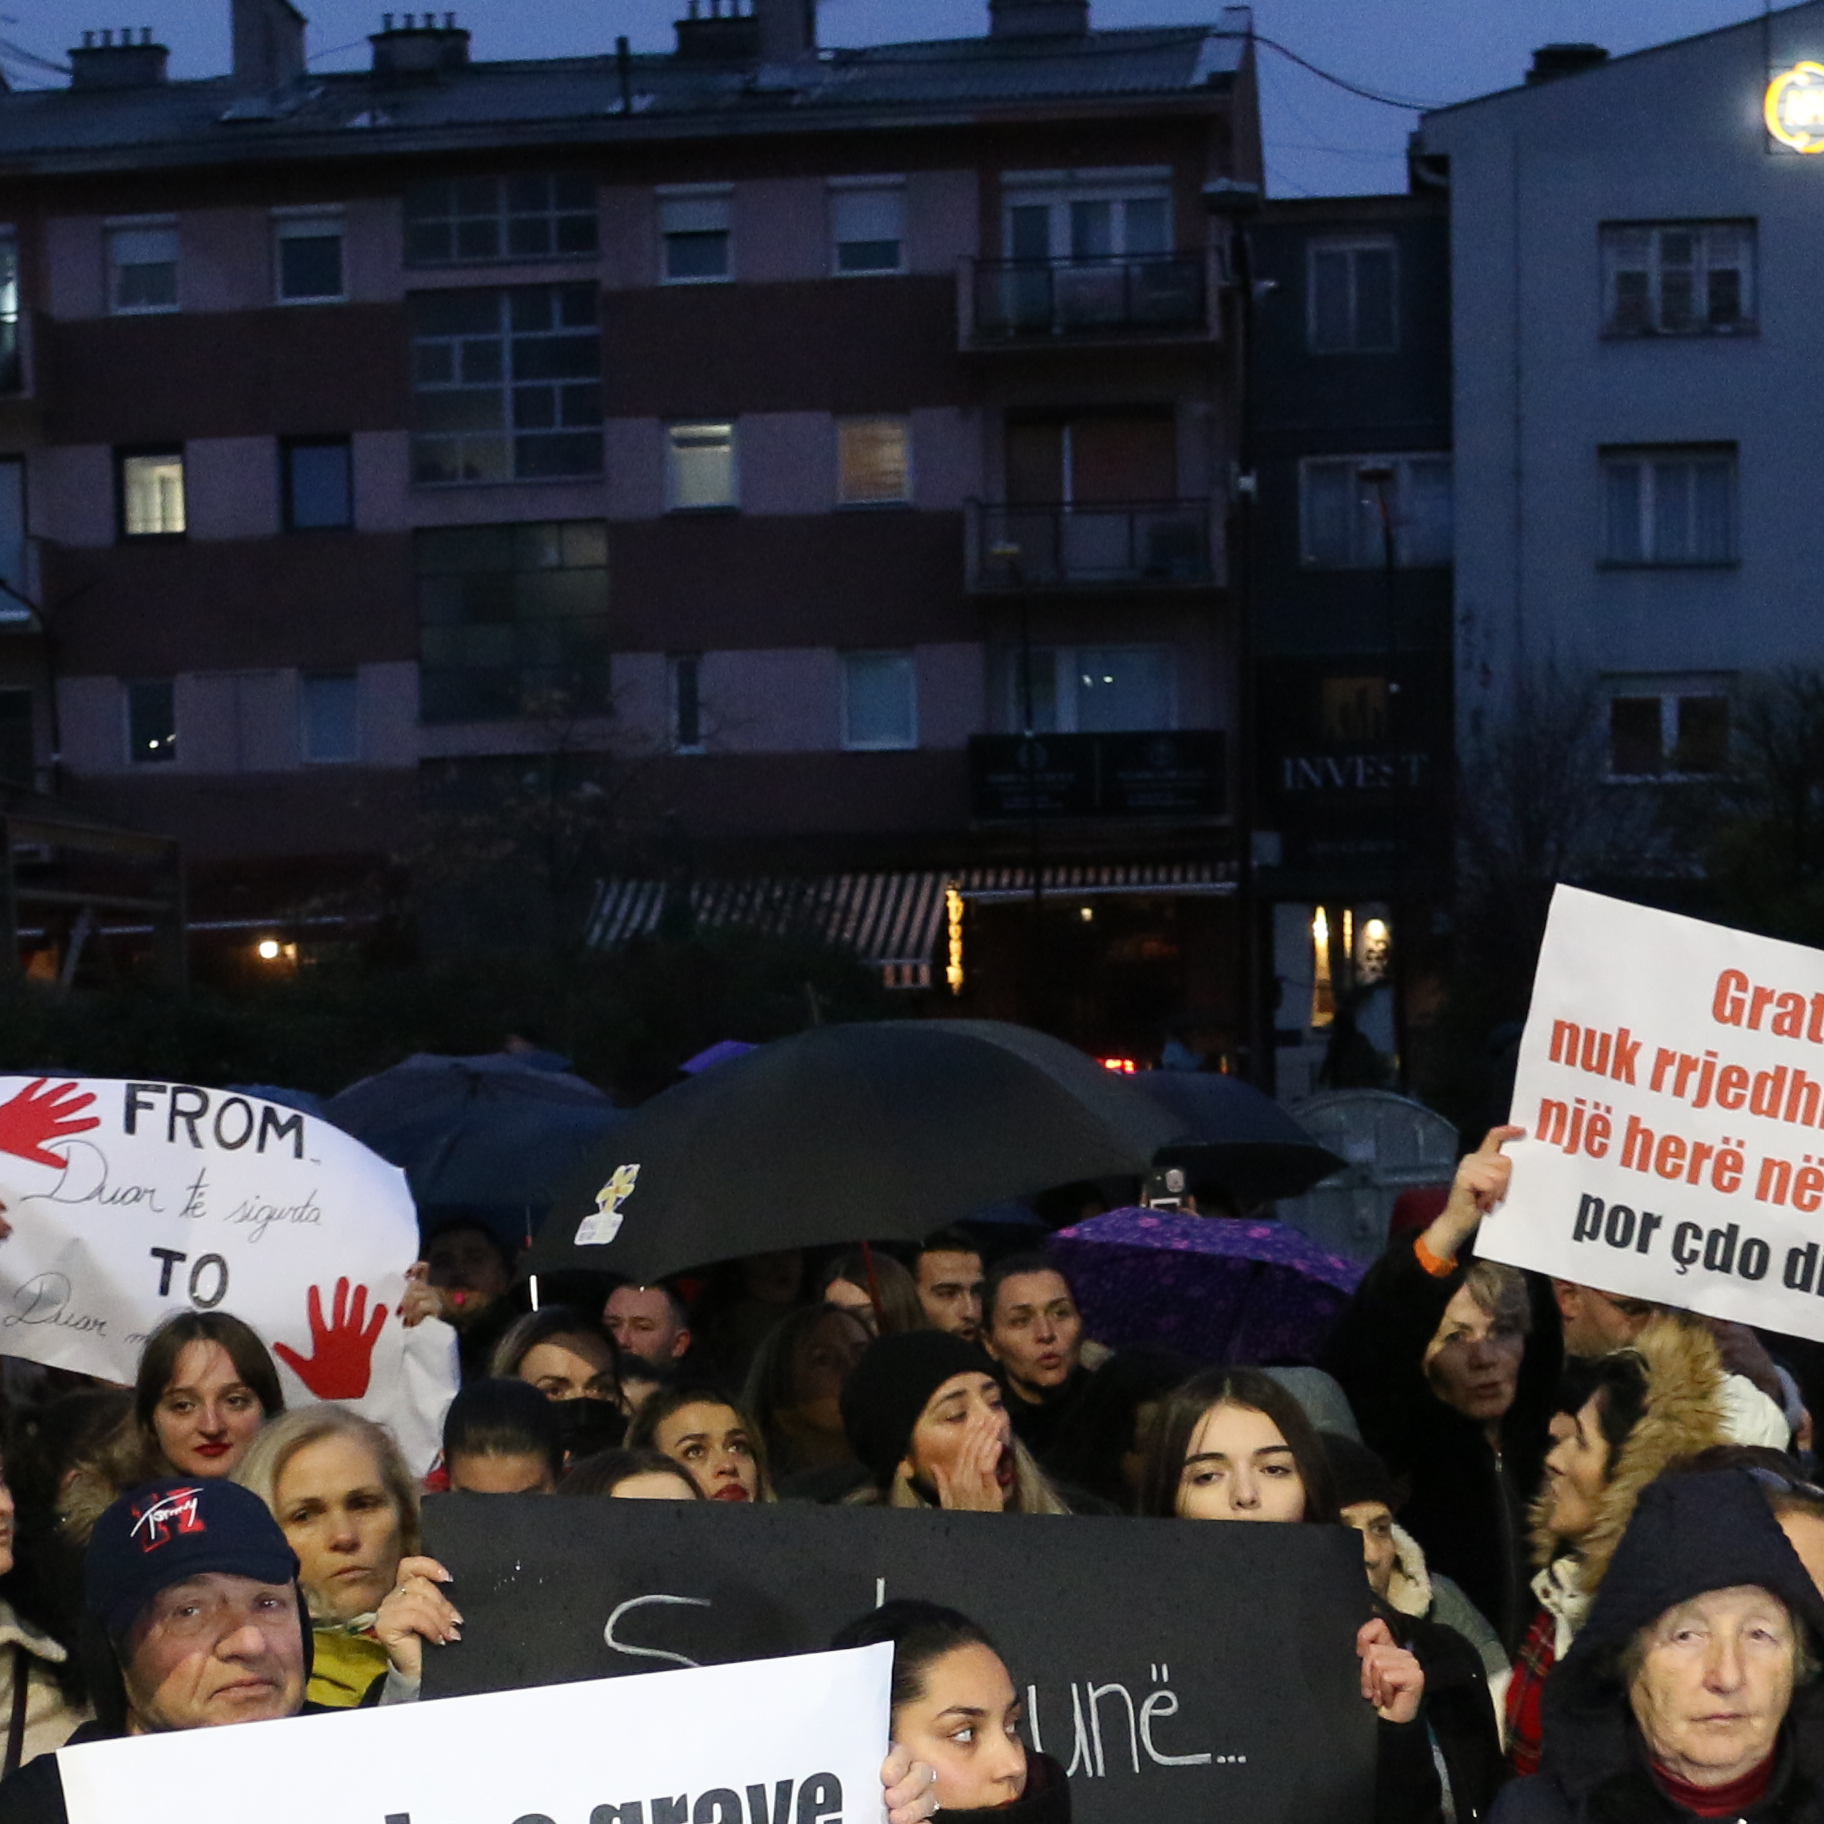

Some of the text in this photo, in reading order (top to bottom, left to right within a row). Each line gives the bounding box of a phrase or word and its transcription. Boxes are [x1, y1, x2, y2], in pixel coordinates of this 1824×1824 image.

[1281, 753, 1432, 790] INVEST
[1550, 1020, 1641, 1084] nuk
[1536, 1099, 1611, 1158] një
[1621, 1116, 1743, 1193] herë
[1757, 1158, 1824, 1212] në
[179, 1168, 207, 1218] të
[1573, 1194, 1661, 1253] por
[1672, 1222, 1770, 1280] çdo
[151, 1247, 229, 1309] TO
[130, 1487, 204, 1540] Tommy
